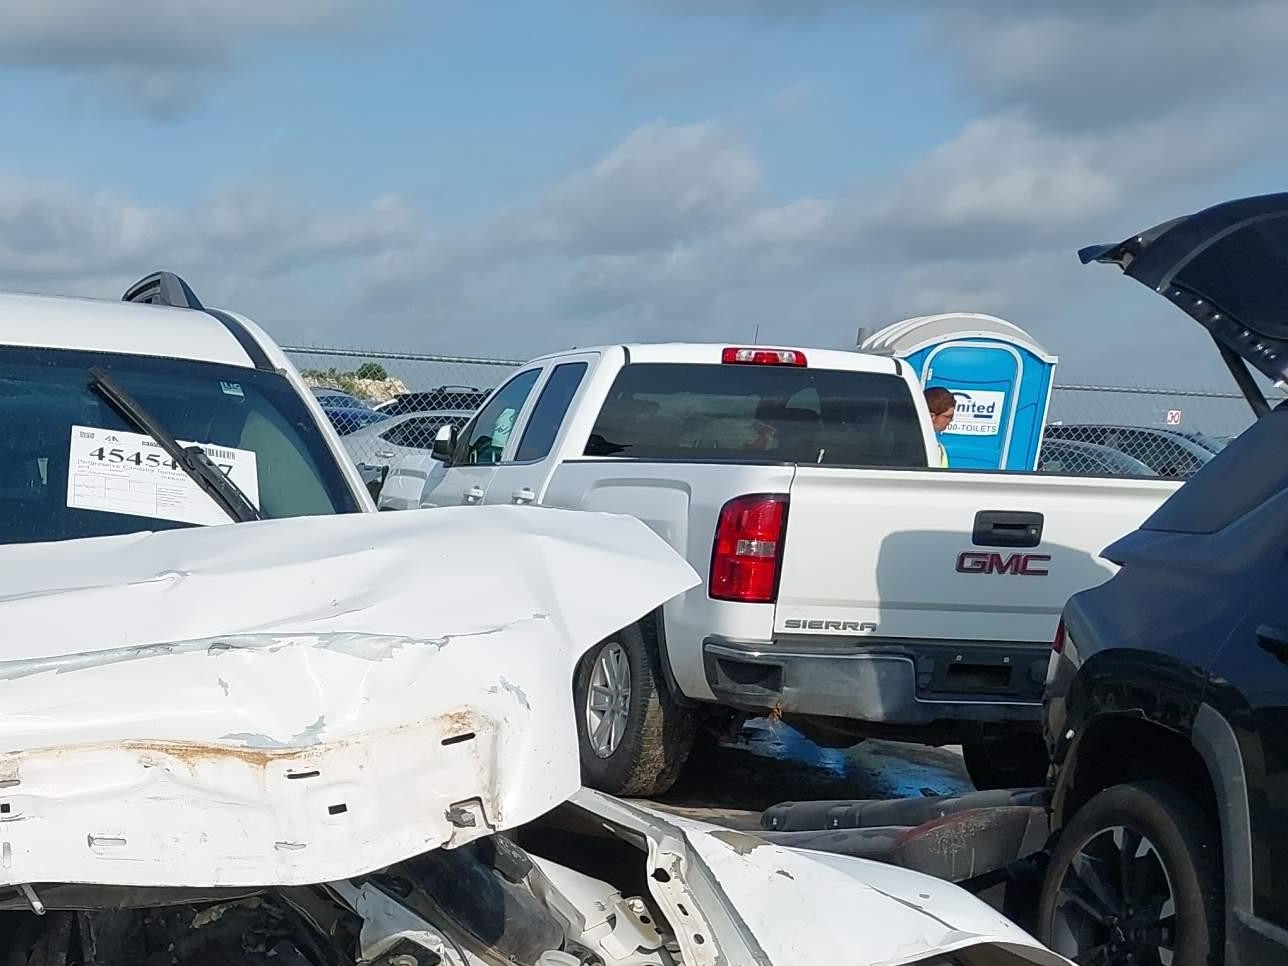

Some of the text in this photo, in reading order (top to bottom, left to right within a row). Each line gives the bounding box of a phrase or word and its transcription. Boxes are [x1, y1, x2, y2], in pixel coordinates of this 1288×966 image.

[955, 400, 996, 414] nited
[947, 423, 997, 433] 00-TOILETS
[89, 446, 233, 477] 454547
[955, 551, 1052, 576] GMC
[784, 619, 878, 633] SIERRA
